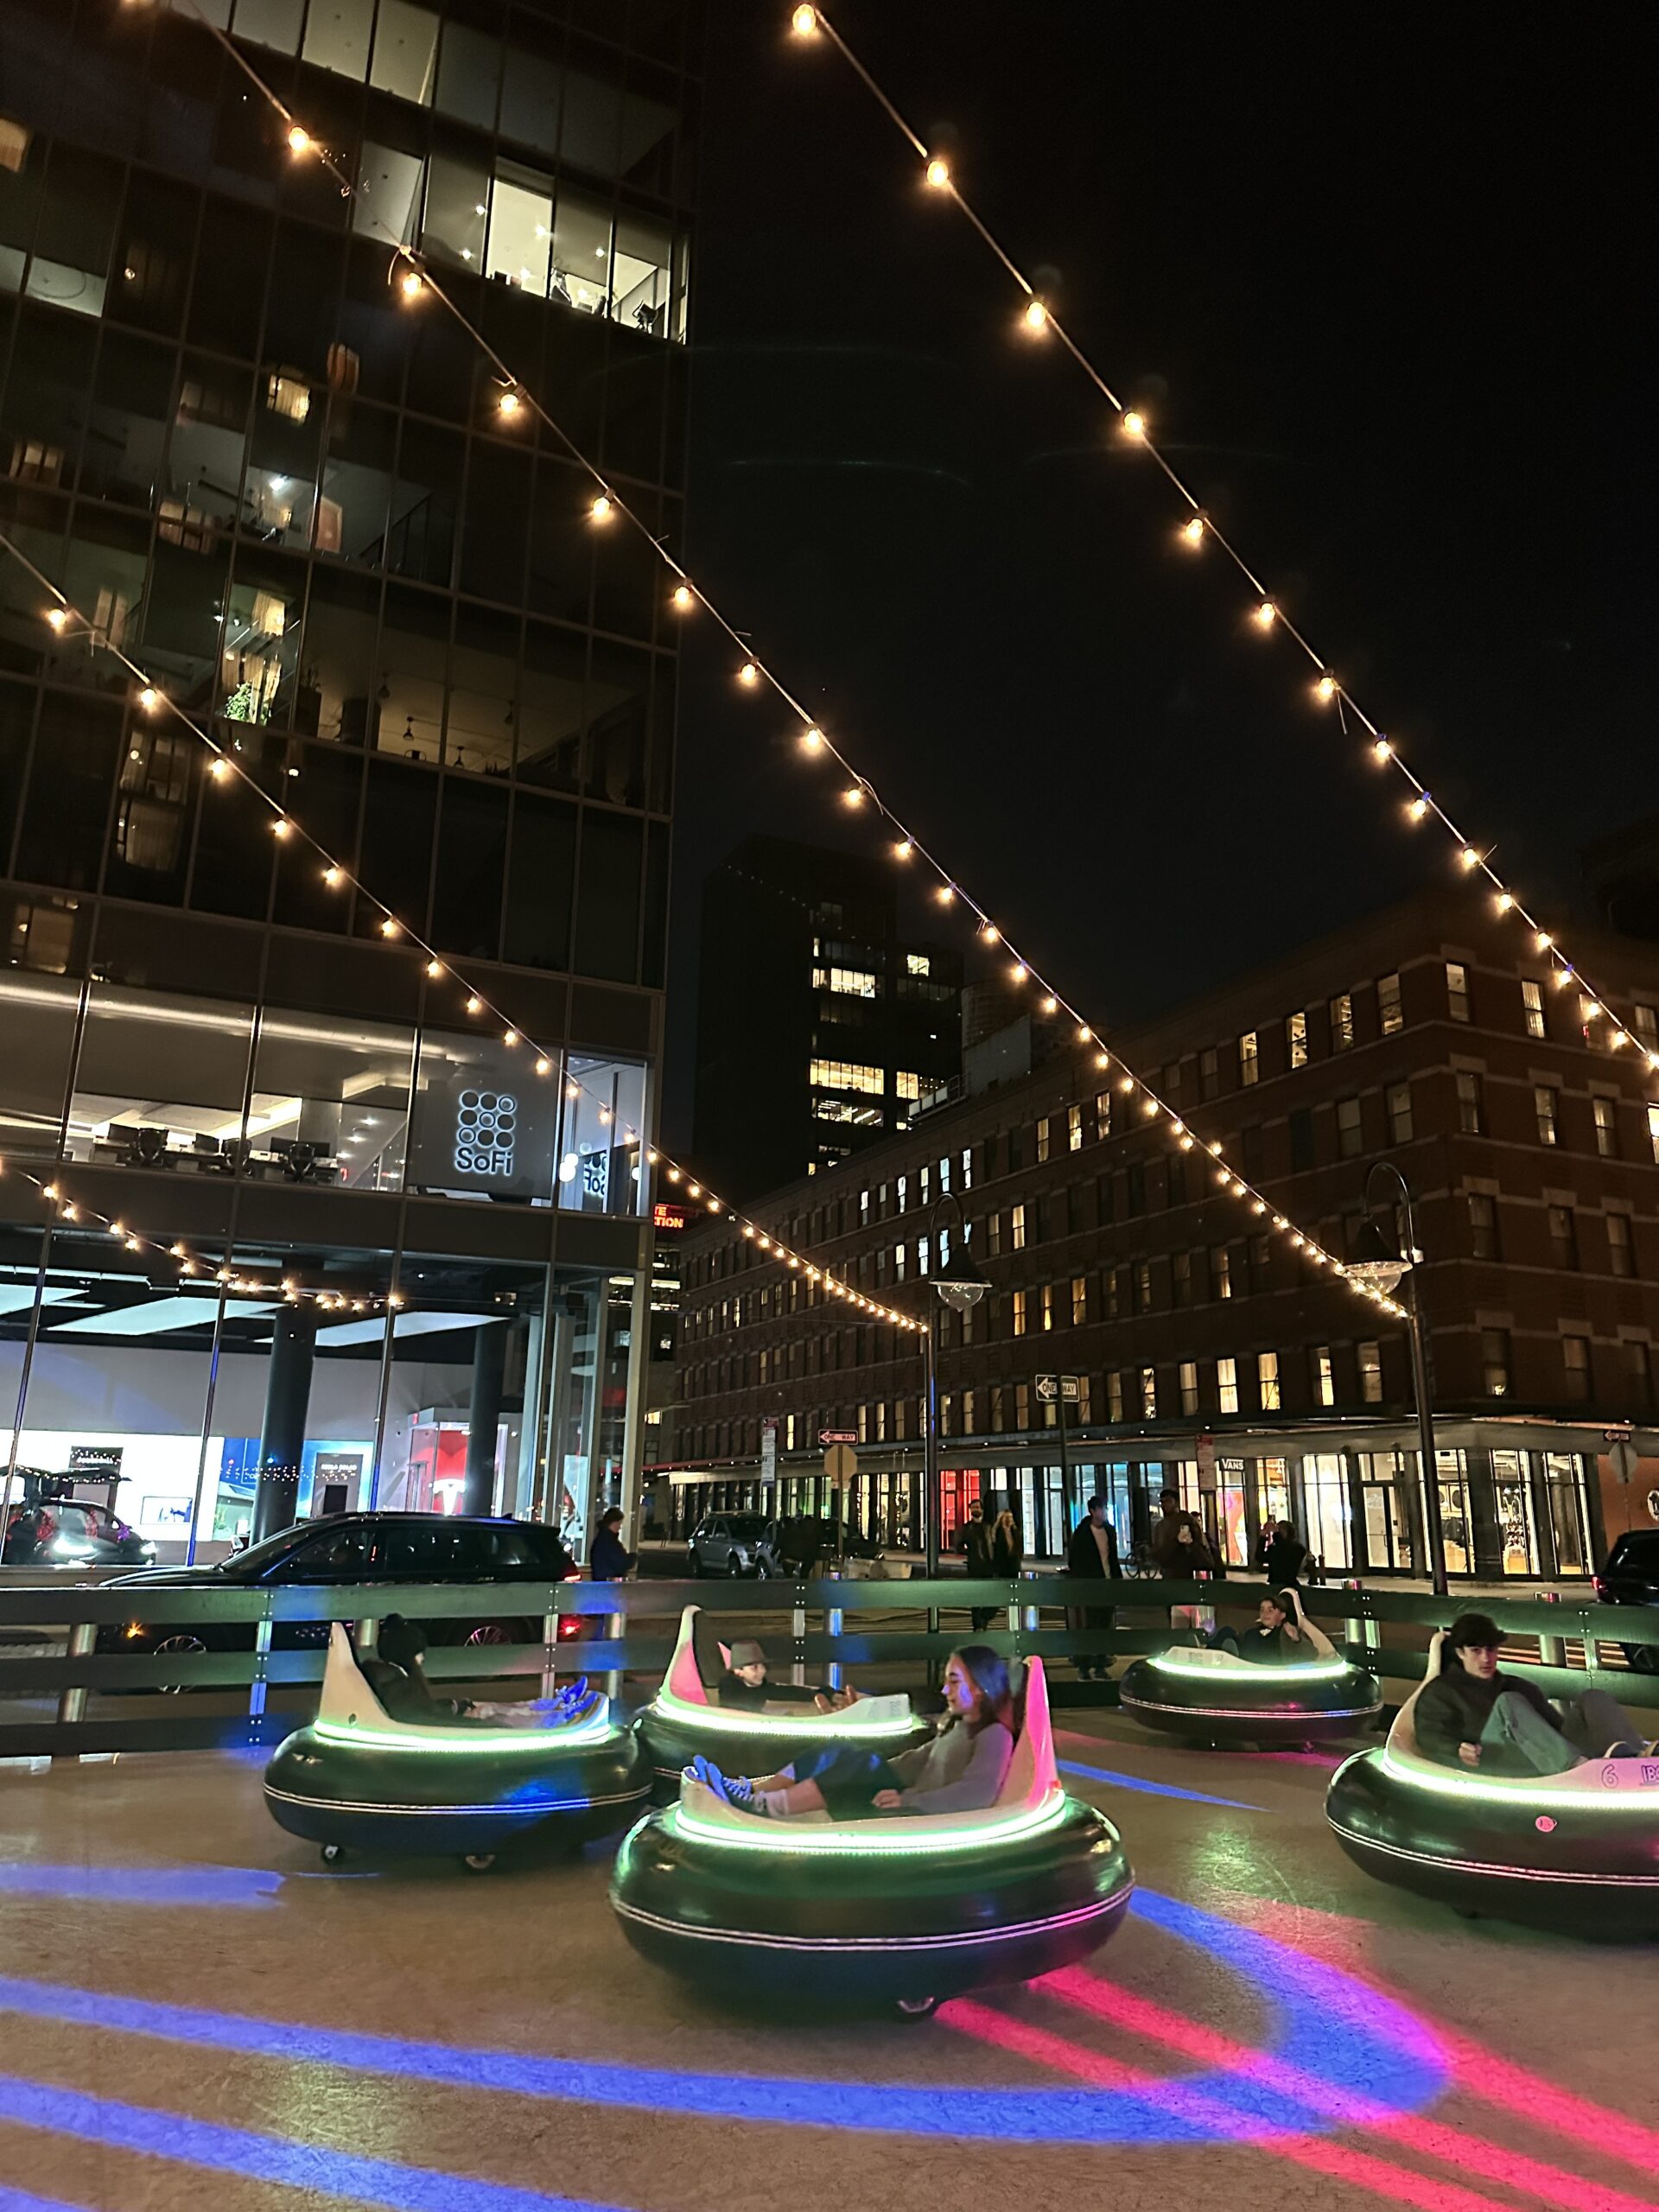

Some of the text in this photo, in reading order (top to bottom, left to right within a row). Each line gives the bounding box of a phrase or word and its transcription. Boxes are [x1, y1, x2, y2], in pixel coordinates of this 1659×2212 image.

[456, 1147, 512, 1175] SoFi
[1042, 1382, 1057, 1393] ONE
[1221, 1458, 1244, 1471] VANS
[1601, 1764, 1619, 1789] 6
